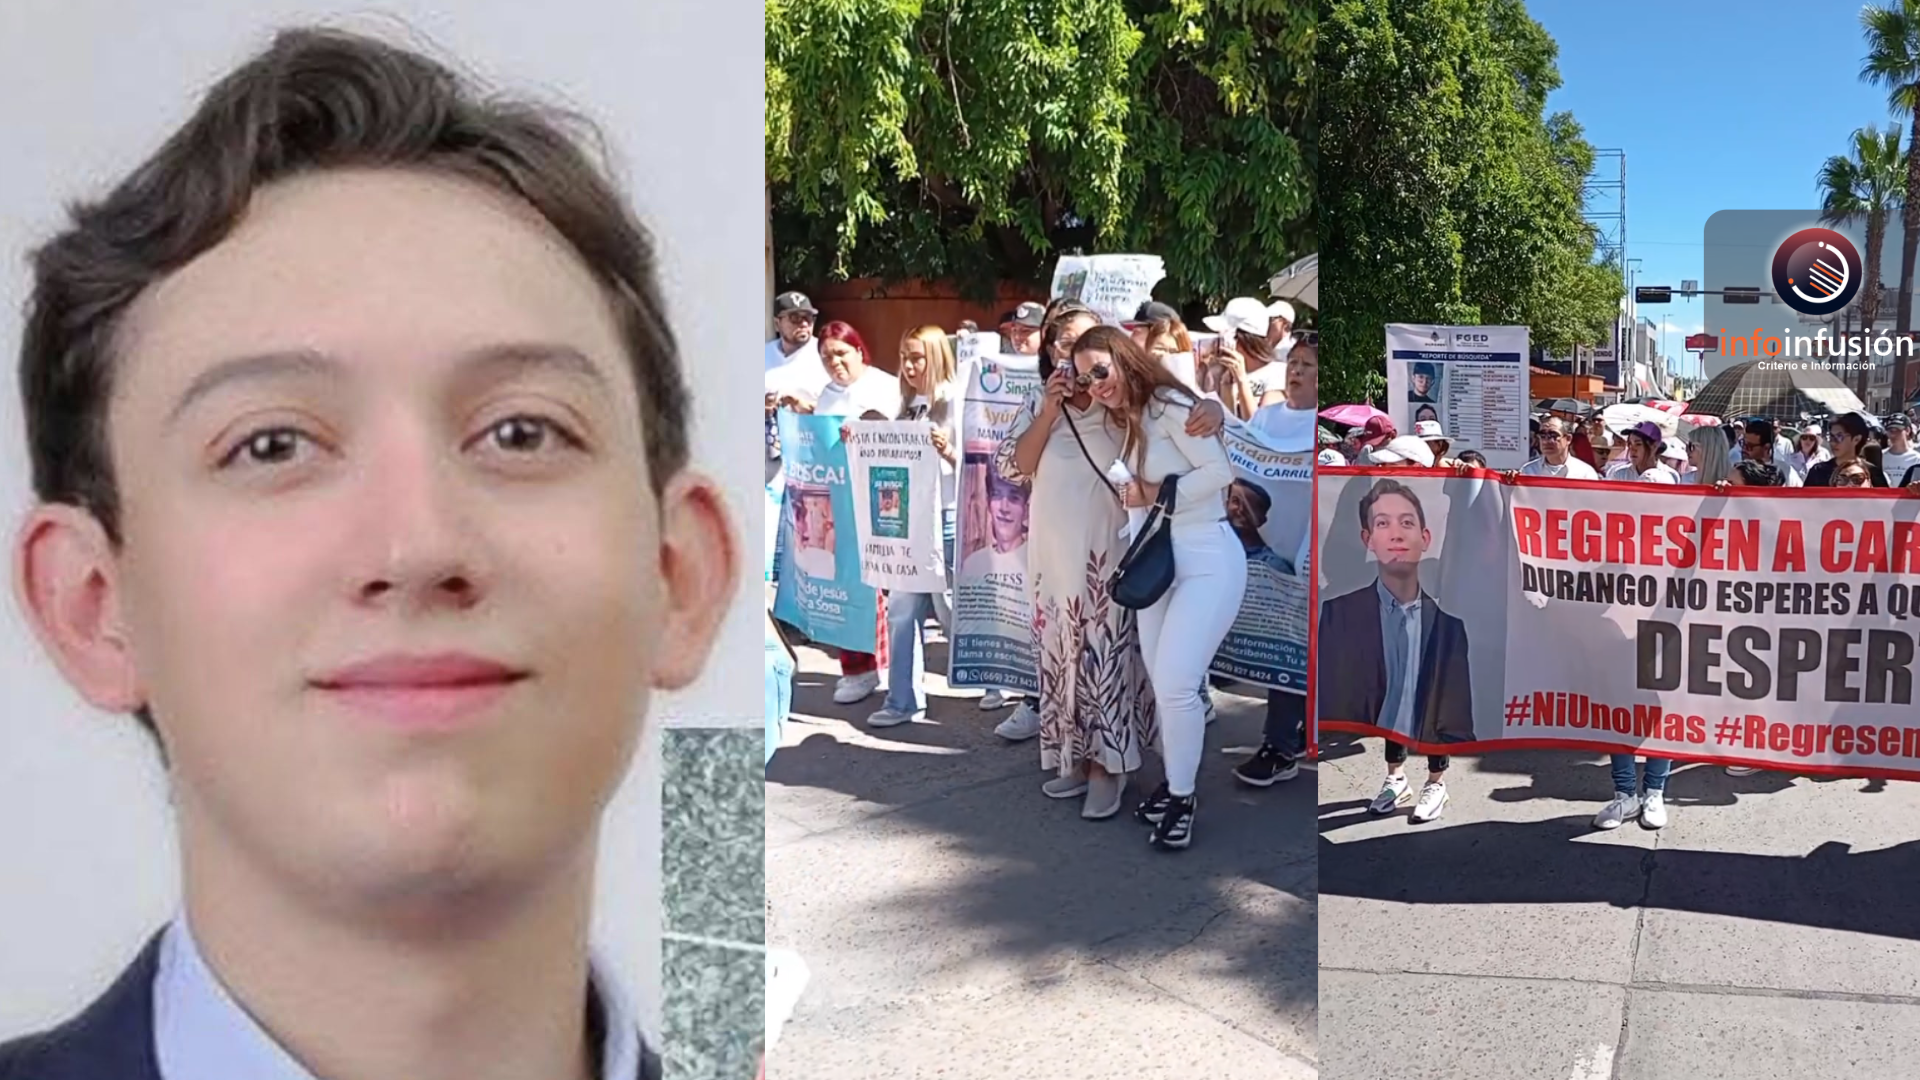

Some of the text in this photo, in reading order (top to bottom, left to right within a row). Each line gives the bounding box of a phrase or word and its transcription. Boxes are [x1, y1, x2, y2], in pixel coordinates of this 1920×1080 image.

[1456, 334, 1489, 342] FGED
[1225, 436, 1304, 466] yúdanos
[1263, 467, 1314, 479] CARRIL
[1513, 507, 1920, 574] REGRESEN A CAR
[1522, 562, 1658, 608] DURANGO
[1665, 576, 1708, 611] NO
[1716, 580, 1850, 615] ESPERES
[1857, 583, 1879, 615] A
[1233, 635, 1296, 654] información
[1636, 619, 1920, 705] DESPER
[1504, 691, 1706, 744] #NiUnoMas
